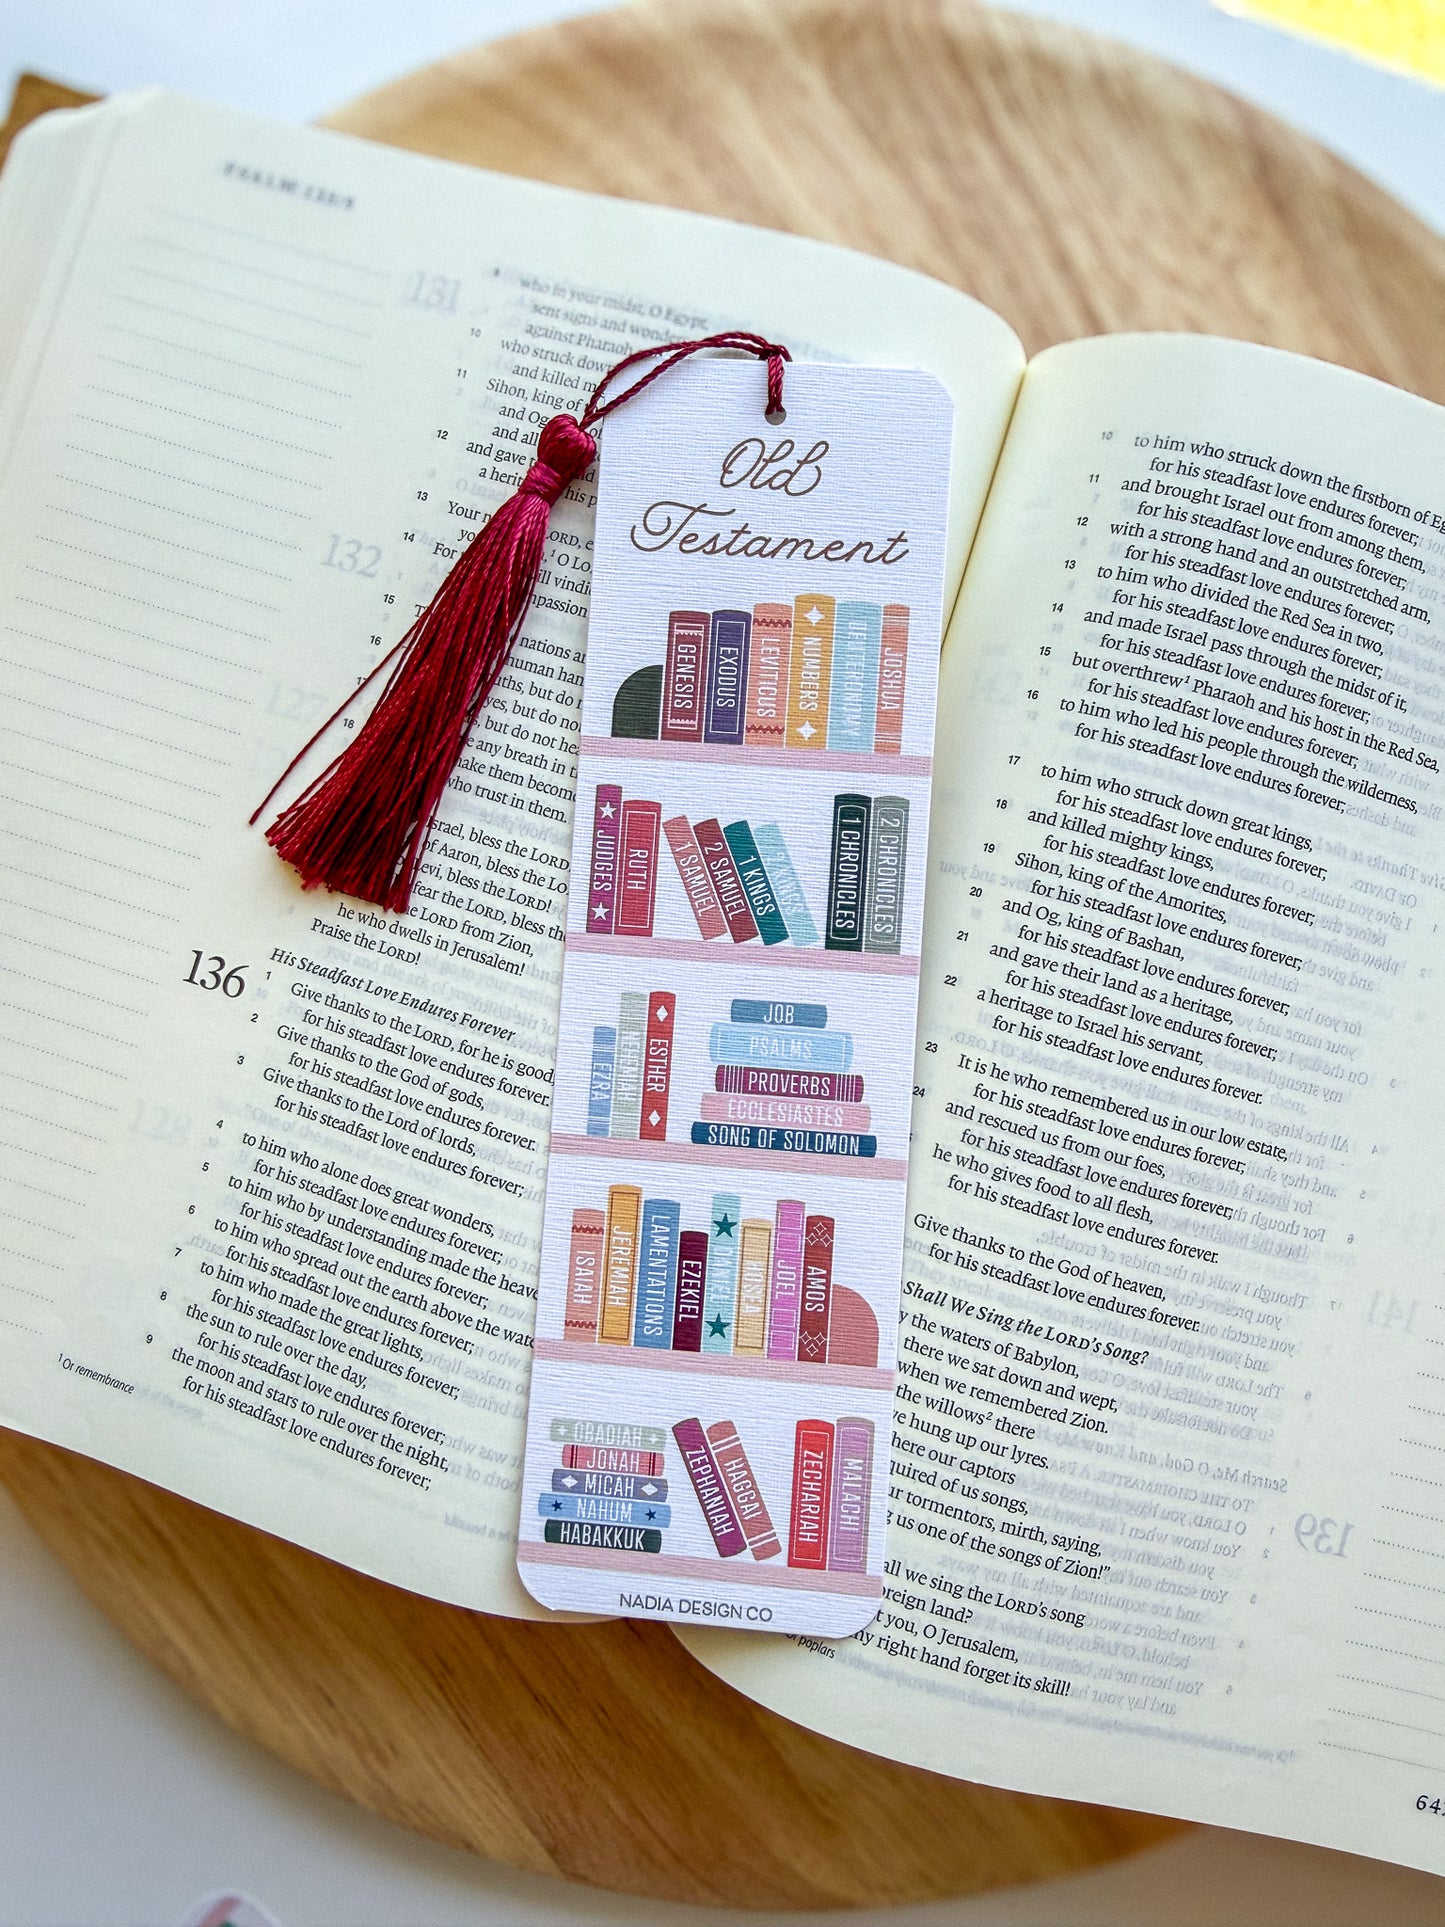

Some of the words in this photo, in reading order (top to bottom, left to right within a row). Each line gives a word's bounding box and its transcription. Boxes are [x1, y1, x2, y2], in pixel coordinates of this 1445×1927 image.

[456, 368, 467, 378] 11
[485, 378, 528, 401] Sihon,
[530, 387, 565, 410] king
[565, 398, 584, 412] of
[511, 364, 539, 380] and
[540, 367, 580, 389] killed
[436, 428, 448, 440] 12
[465, 441, 494, 457] and
[492, 448, 526, 465] gave
[720, 438, 829, 496] Old
[1152, 434, 1185, 452] him
[1190, 441, 1224, 459] who
[1226, 450, 1277, 472] struck
[1278, 460, 1322, 486] down
[1325, 475, 1350, 495] the
[1350, 483, 1411, 518] firstborn
[1413, 510, 1431, 524] of
[630, 500, 910, 564] Testament
[1076, 516, 1089, 526] 12
[1110, 520, 1144, 538] with
[1147, 528, 1157, 540] a
[1160, 530, 1214, 554] strong
[1214, 538, 1257, 563] hand
[1258, 554, 1289, 572] and
[1290, 564, 1309, 579] an
[1312, 571, 1399, 611] outstretched
[1399, 602, 1430, 625] arm,
[383, 593, 395, 605] 15
[370, 635, 382, 646] 16
[672, 644, 697, 710] GENESIS
[716, 646, 739, 709] EXODUS
[756, 638, 780, 719] LEVITICUS
[799, 636, 823, 712] NUMBERS
[880, 646, 906, 711] JOSHUA
[342, 718, 355, 730] 18
[1008, 755, 1021, 765] 17
[474, 784, 509, 805] trust
[508, 792, 524, 810] in
[527, 799, 567, 823] them.
[880, 818, 900, 828] 2
[593, 830, 616, 892] JUDGES
[626, 849, 648, 890] RUTH
[674, 842, 694, 852] 1
[704, 842, 724, 856] 2
[739, 855, 756, 866] 1
[680, 855, 716, 917] SAMUEL
[710, 857, 746, 920] SAMUEL
[743, 868, 776, 916] KINGS
[836, 830, 860, 929] CHRONICLES
[874, 836, 898, 934] CHRONICLES
[418, 906, 458, 930] LORD
[459, 919, 494, 943] from
[496, 931, 533, 958] Zion,
[433, 934, 449, 952] in
[448, 940, 525, 976] Jerusalem!
[182, 949, 249, 998] 136
[266, 970, 271, 980] 1
[269, 947, 297, 966] His
[296, 956, 364, 989] Steadfast
[363, 979, 399, 1001] Love
[397, 991, 459, 1022] Endures
[458, 1011, 516, 1041] Forever
[290, 982, 322, 1003] Give
[323, 992, 370, 1020] thanks
[372, 1010, 387, 1025] to
[388, 1015, 412, 1034] the
[411, 1023, 454, 1052] LORD,
[456, 1038, 480, 1058] for
[480, 1045, 500, 1065] he
[500, 1053, 515, 1070] is
[764, 1004, 794, 1024] JOB
[301, 1008, 324, 1027] for
[323, 1015, 346, 1035] his
[346, 1027, 408, 1057] steadfast
[407, 1044, 438, 1068] love
[438, 1060, 496, 1088] endures
[496, 1077, 550, 1107] forever.
[618, 1032, 641, 1100] NEHEMIAH
[646, 1038, 668, 1093] ESTHER
[750, 1036, 813, 1058] PSALMS
[924, 1040, 938, 1053] 23
[591, 1062, 612, 1100] EZRA
[748, 1071, 831, 1096] PROVERBS
[727, 1099, 844, 1127] ECCLESIASTES
[956, 1053, 972, 1070] It
[973, 1057, 987, 1074] is
[988, 1061, 1010, 1082] he
[1013, 1072, 1048, 1093] who
[1050, 1084, 1149, 1122] remembered
[1151, 1113, 1170, 1128] us
[1170, 1114, 1187, 1133] in
[1189, 1124, 1217, 1141] our
[1217, 1127, 1245, 1148] low
[1246, 1139, 1287, 1162] estate,
[708, 1124, 750, 1147] SONG
[758, 1128, 776, 1148] OF
[784, 1130, 860, 1156] SOLOMON
[573, 1250, 596, 1305] ISAIAH
[608, 1225, 634, 1306] JEREMIAH
[644, 1215, 671, 1336] LAMENTATIONS
[710, 1246, 732, 1303] DANIEL
[742, 1260, 765, 1314] HOSEA
[775, 1259, 796, 1300] JOEL
[804, 1265, 827, 1313] AMOS
[678, 1260, 702, 1322] EZEKIEL
[145, 1333, 153, 1344] 9
[904, 1279, 948, 1307] Shall
[951, 1295, 975, 1316] We
[975, 1305, 1015, 1332] Sing
[1015, 1318, 1043, 1337] the
[1102, 1341, 1149, 1366] Song?
[62, 1357, 74, 1371] Or
[74, 1365, 134, 1394] remembrance
[902, 1335, 944, 1361] there
[947, 1352, 970, 1370] we
[971, 1361, 996, 1378] sat
[997, 1366, 1042, 1392] down
[1044, 1383, 1076, 1401] and
[1078, 1390, 1117, 1413] wept,
[171, 1346, 194, 1366] the
[194, 1358, 235, 1384] moon
[236, 1375, 265, 1396] and
[264, 1387, 299, 1409] stars
[300, 1400, 315, 1416] to
[316, 1408, 346, 1429] rule
[346, 1421, 379, 1442] over
[379, 1432, 404, 1453] the
[404, 1444, 448, 1472] night,
[573, 1422, 642, 1447] OBADIAH
[586, 1449, 640, 1473] JONAH
[584, 1473, 635, 1498] MICAH
[686, 1445, 735, 1537] ZEPHANIAH
[724, 1458, 763, 1520] HAGGAI
[798, 1449, 824, 1543] ZECHARIAH
[840, 1458, 864, 1531] MALACHI
[576, 1498, 633, 1523] NAHUM
[560, 1522, 646, 1550] HABAKKUK
[619, 1593, 673, 1612] NADIA
[678, 1600, 743, 1620] DESIGN
[746, 1606, 773, 1622] CO
[798, 1636, 836, 1658] poplars
[875, 1634, 918, 1659] right
[919, 1645, 961, 1672] hand
[962, 1659, 1011, 1684] forget
[1011, 1670, 1032, 1689] its
[1032, 1676, 1071, 1696] skill!
[922, 1623, 937, 1639] O
[936, 1627, 1018, 1664] Jerusalem,
